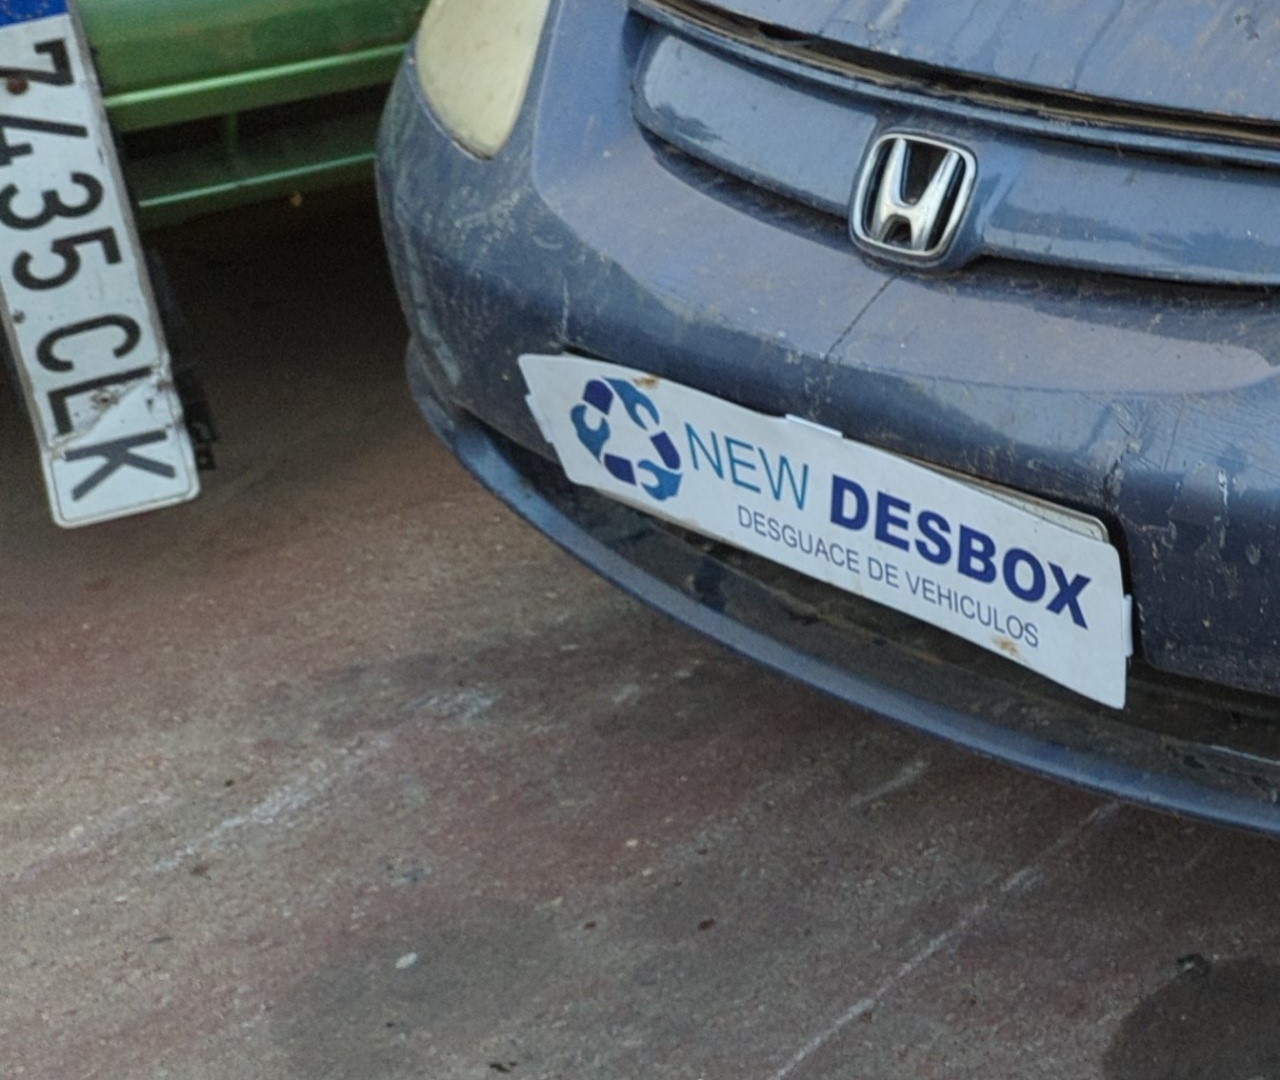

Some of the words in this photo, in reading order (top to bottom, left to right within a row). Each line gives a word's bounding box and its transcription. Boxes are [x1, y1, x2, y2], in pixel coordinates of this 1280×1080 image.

[0, 38, 122, 291] 7435
[36, 314, 176, 501] CLK
[684, 422, 809, 510] NEW
[829, 475, 1091, 630] DESBOX
[737, 505, 860, 574] DESGUACE
[868, 556, 900, 589] DE
[906, 571, 1039, 648] VEHICULOS
